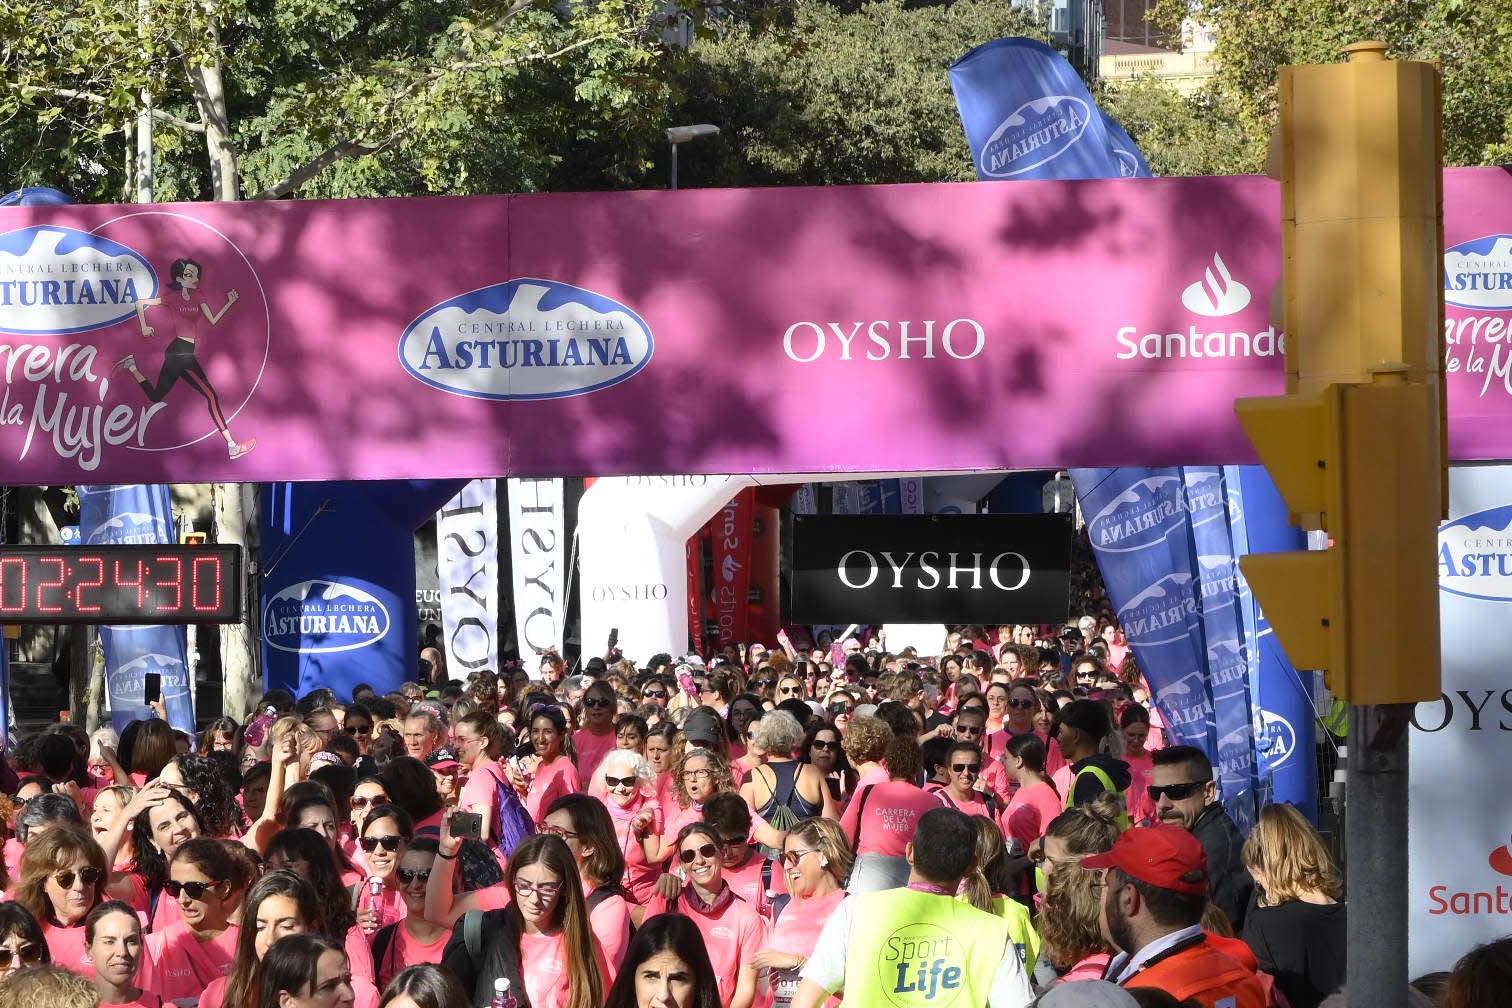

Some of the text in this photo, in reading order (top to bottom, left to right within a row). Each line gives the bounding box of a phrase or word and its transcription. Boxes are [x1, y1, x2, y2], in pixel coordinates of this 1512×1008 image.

[59, 262, 134, 274] LECHERA
[458, 320, 625, 334] CENTRAL LECHERA
[782, 319, 986, 362] OYSHO
[419, 326, 634, 370] ASTURIANA
[1116, 326, 1287, 360] Santande
[1467, 347, 1484, 373] la
[0, 388, 24, 426] la
[19, 378, 168, 470] Mujer
[837, 550, 1032, 592] OYSHO
[592, 583, 668, 601] OYSHO
[266, 608, 381, 638] ASTURIANA
[875, 807, 916, 817] CARRERA
[885, 935, 953, 963] Sport
[893, 958, 963, 1000] Life
